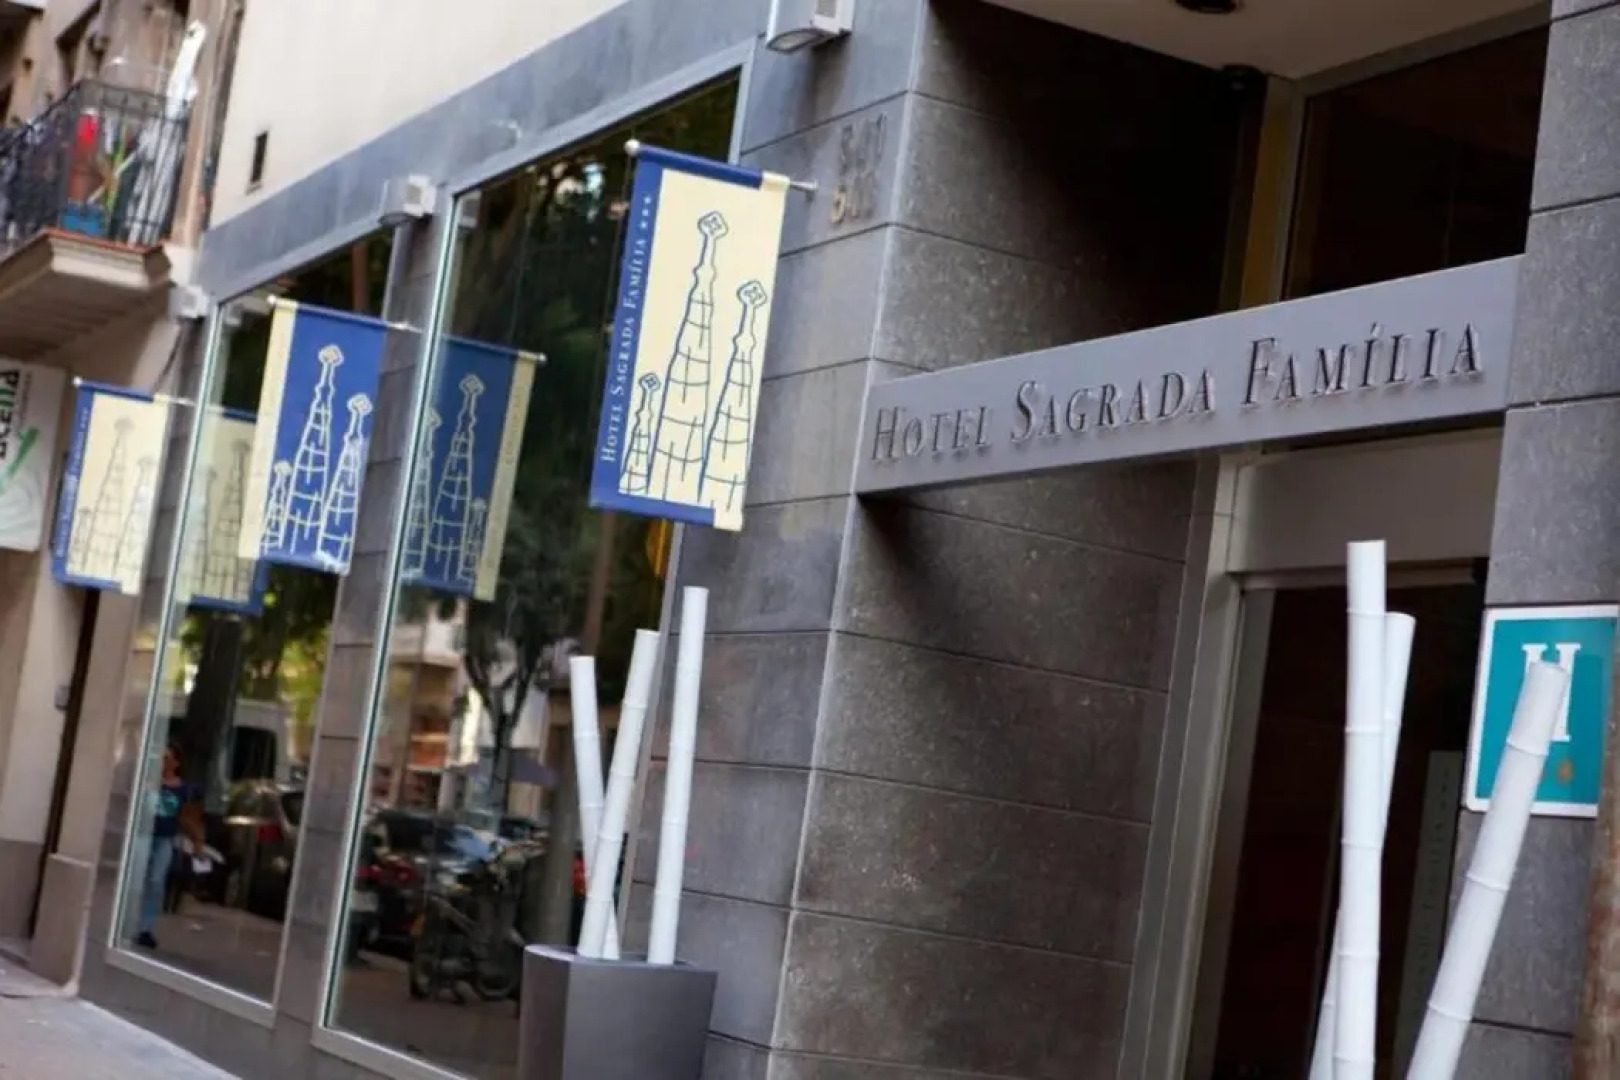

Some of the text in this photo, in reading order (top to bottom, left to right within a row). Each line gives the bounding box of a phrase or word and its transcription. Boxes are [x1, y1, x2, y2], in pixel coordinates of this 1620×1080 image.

[601, 239, 647, 463] HOTEL SAGRADA FAMÍLIA
[870, 321, 1482, 462] HOTEL SAGRADA FAMÍLIA
